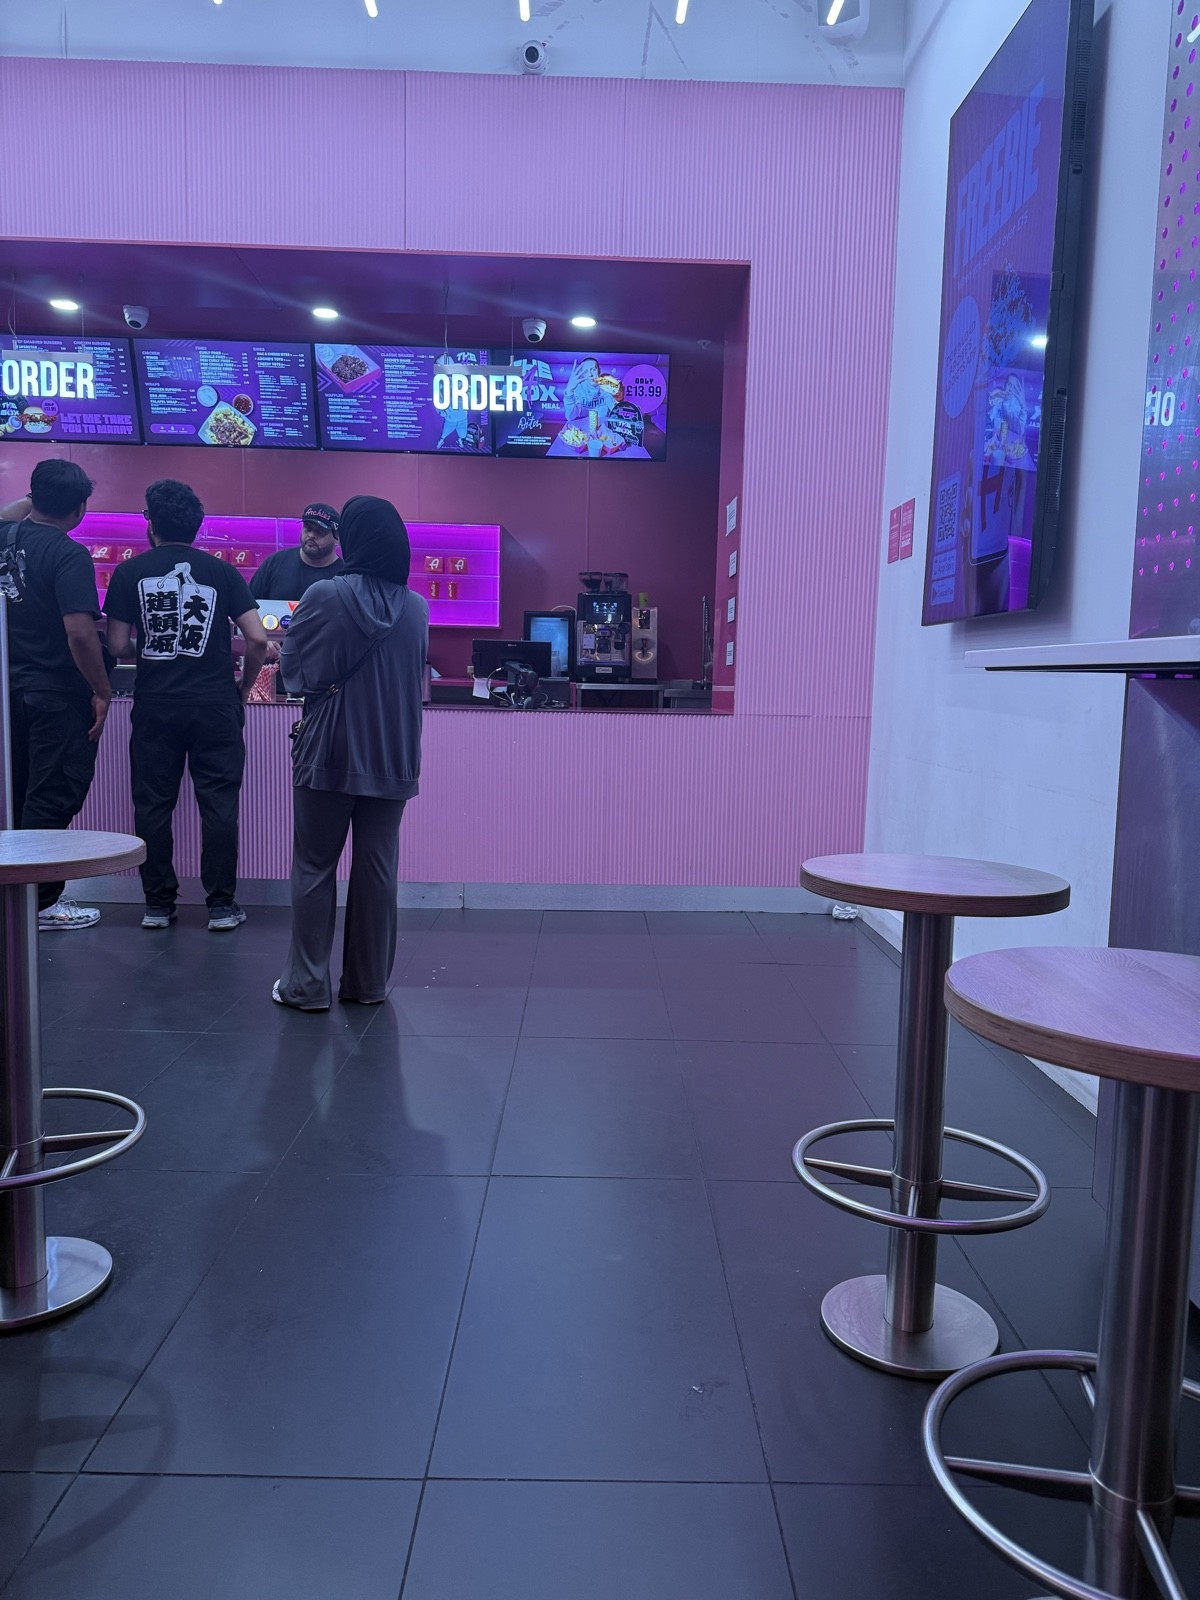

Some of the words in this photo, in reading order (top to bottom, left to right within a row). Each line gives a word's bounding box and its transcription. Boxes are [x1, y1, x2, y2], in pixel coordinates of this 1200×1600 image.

[954, 77, 1044, 277] FREEBIE
[457, 352, 477, 362] THE
[2, 359, 95, 399] ORDER
[433, 373, 523, 412] ORDER
[626, 385, 662, 398] £13.99
[60, 413, 81, 423] LET
[83, 414, 101, 424] ME
[102, 414, 132, 425] TAKE
[61, 424, 83, 433] YOU
[84, 424, 95, 433] TO
[235, 551, 246, 564] A
[429, 558, 439, 570] A
[455, 559, 464, 571] A
[179, 595, 209, 653] 大阪
